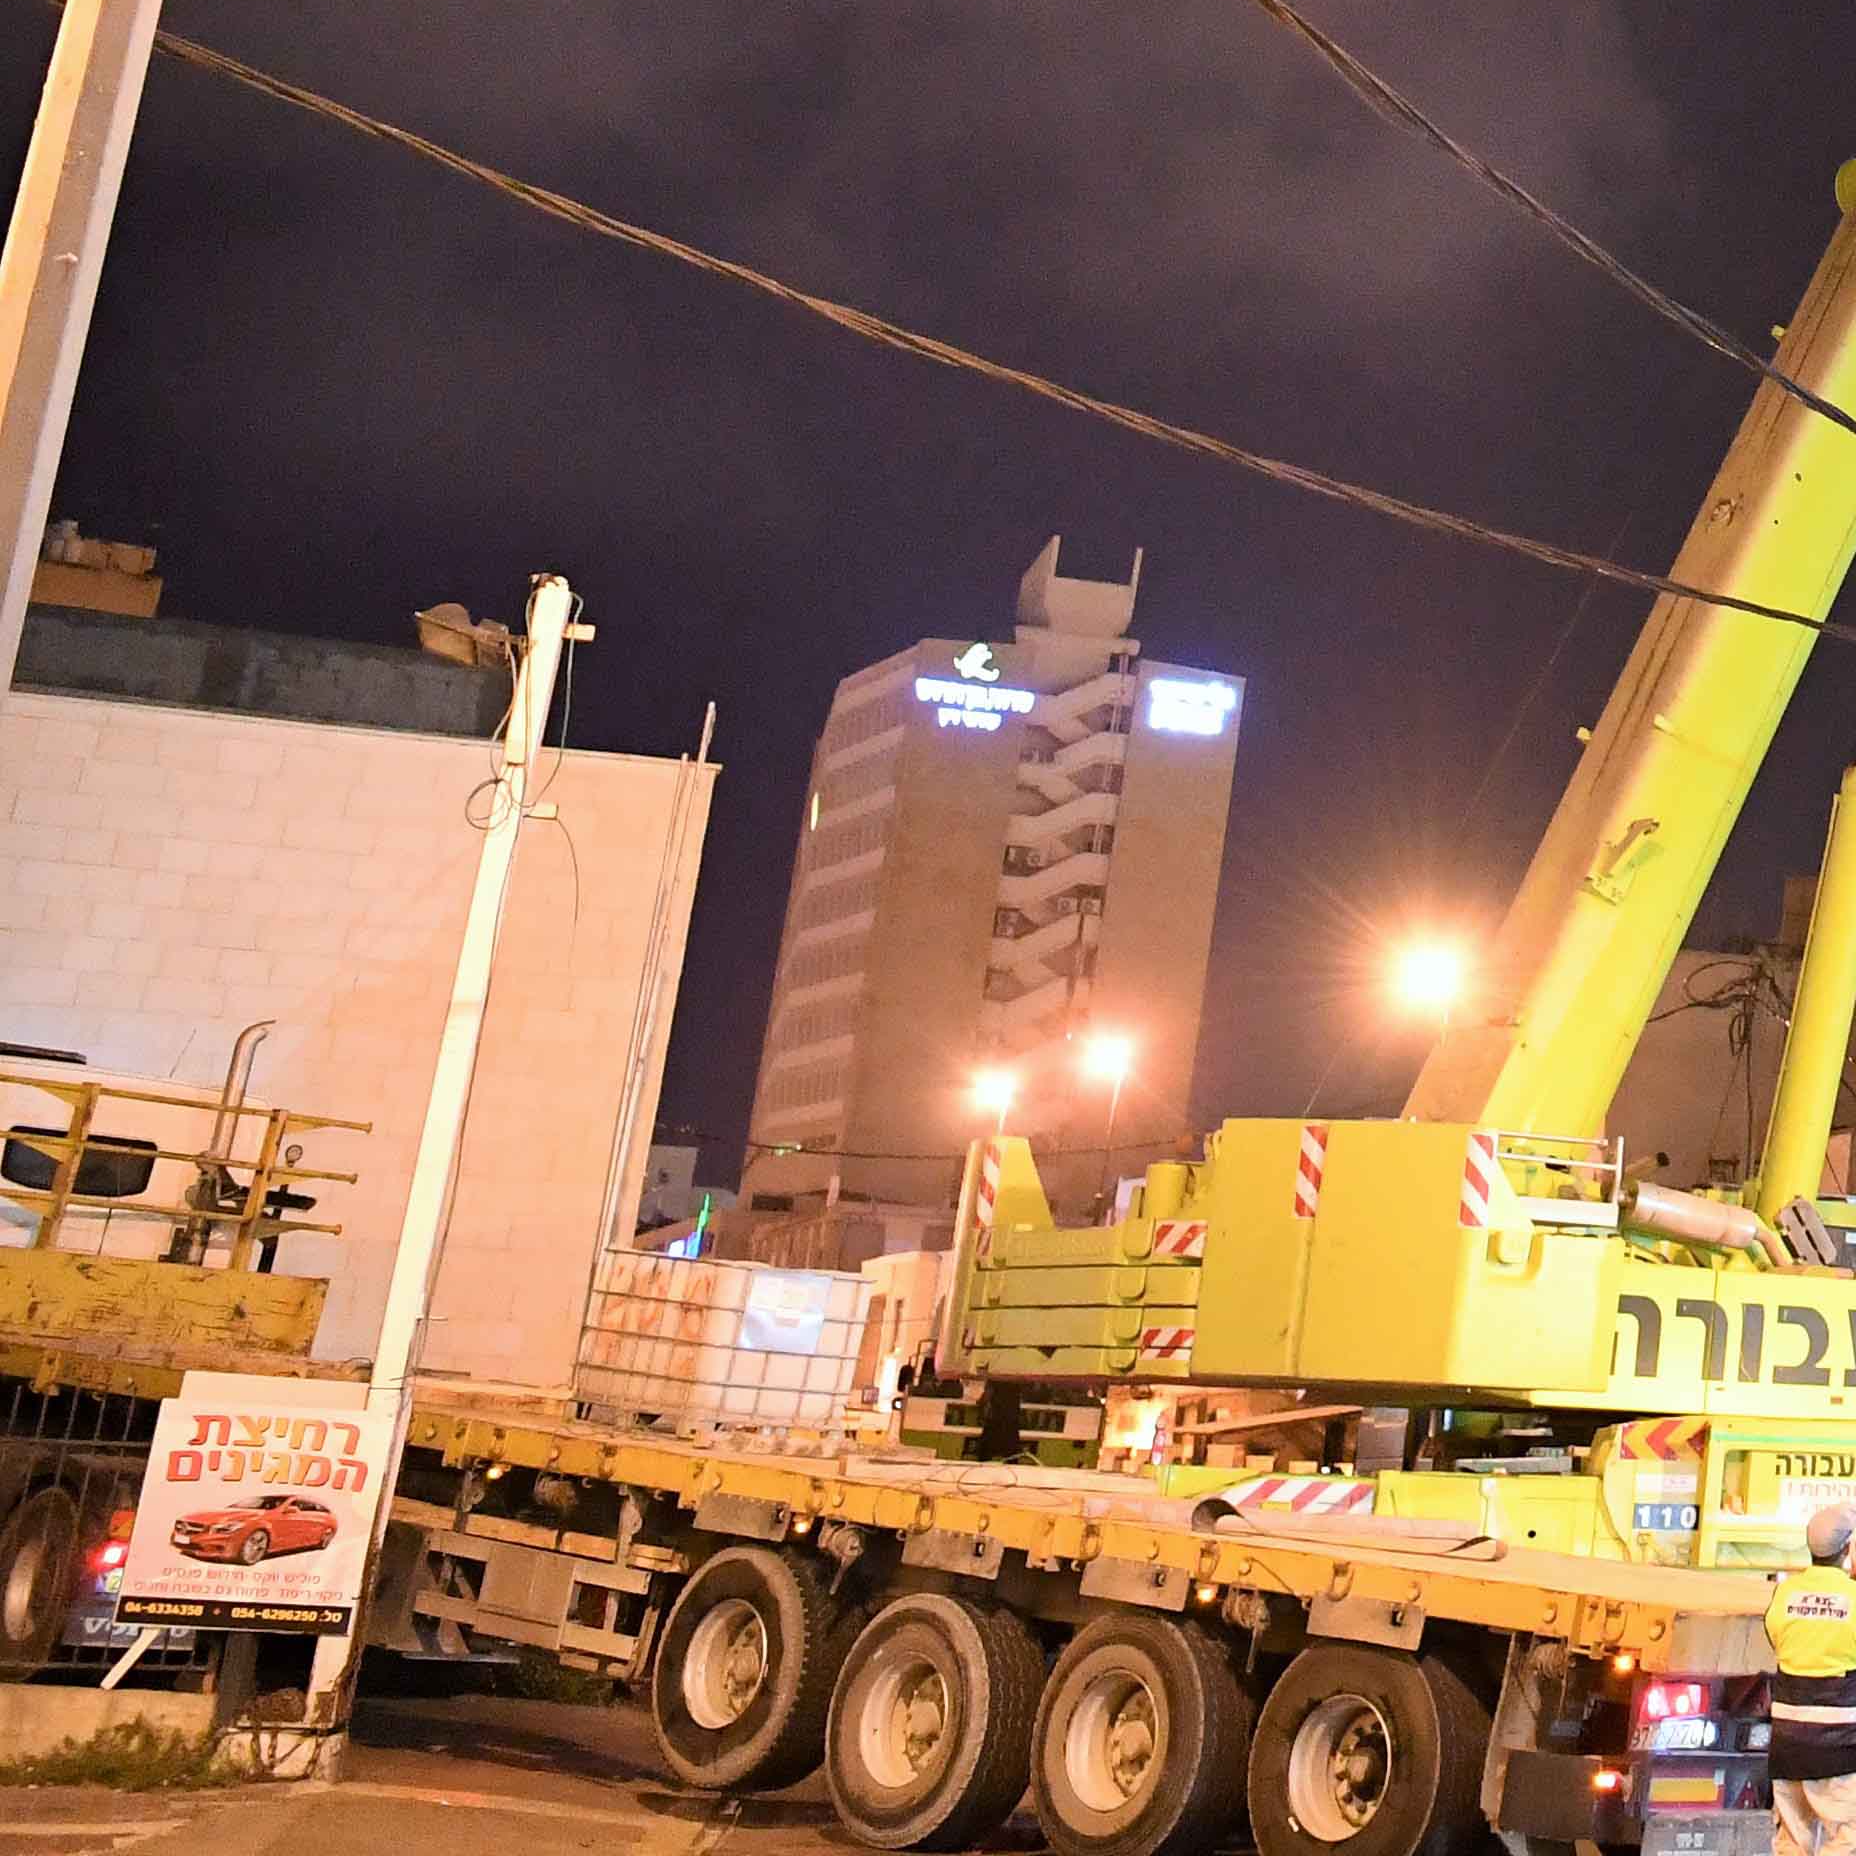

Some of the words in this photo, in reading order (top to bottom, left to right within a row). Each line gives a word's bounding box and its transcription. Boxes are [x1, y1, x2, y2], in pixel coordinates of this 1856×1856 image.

[188, 1413, 361, 1456] רחיצת
[165, 1449, 369, 1493] המגינים
[1637, 1504, 1698, 1529] 110
